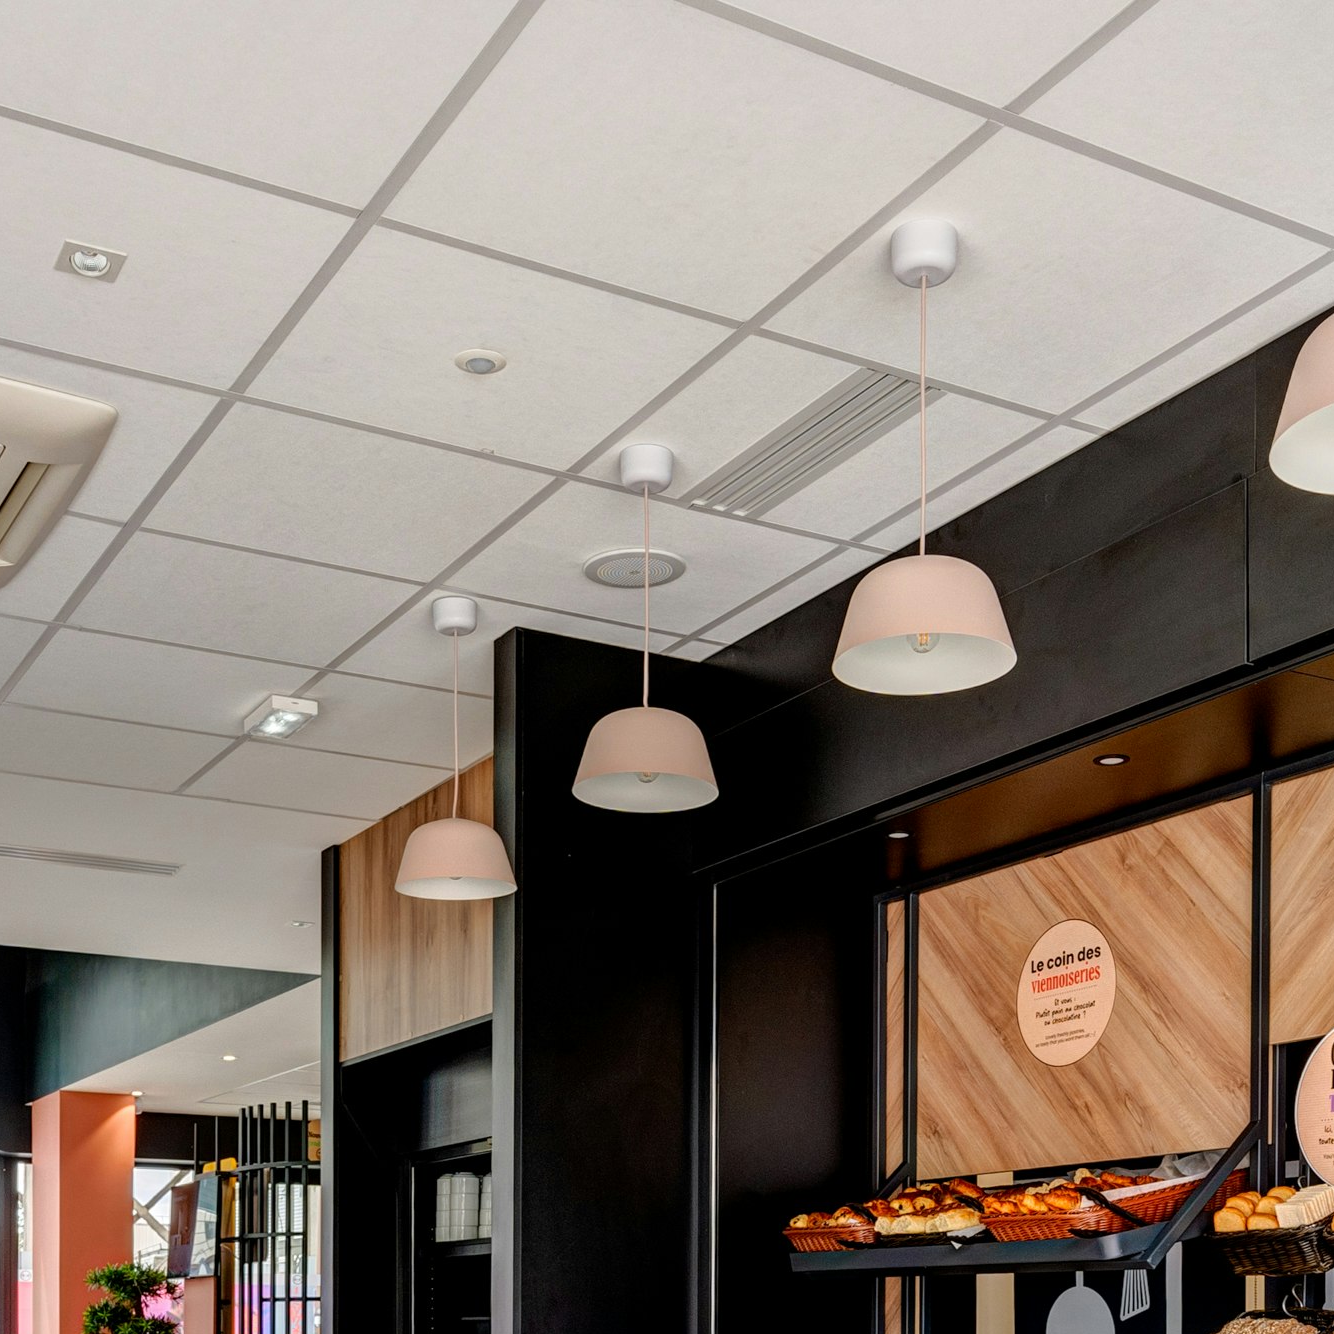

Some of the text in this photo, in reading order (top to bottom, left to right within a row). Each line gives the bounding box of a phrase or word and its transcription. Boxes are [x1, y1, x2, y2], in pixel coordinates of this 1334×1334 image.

[1031, 946, 1101, 974] Le coin des
[1031, 961, 1100, 994] viennoiseries
